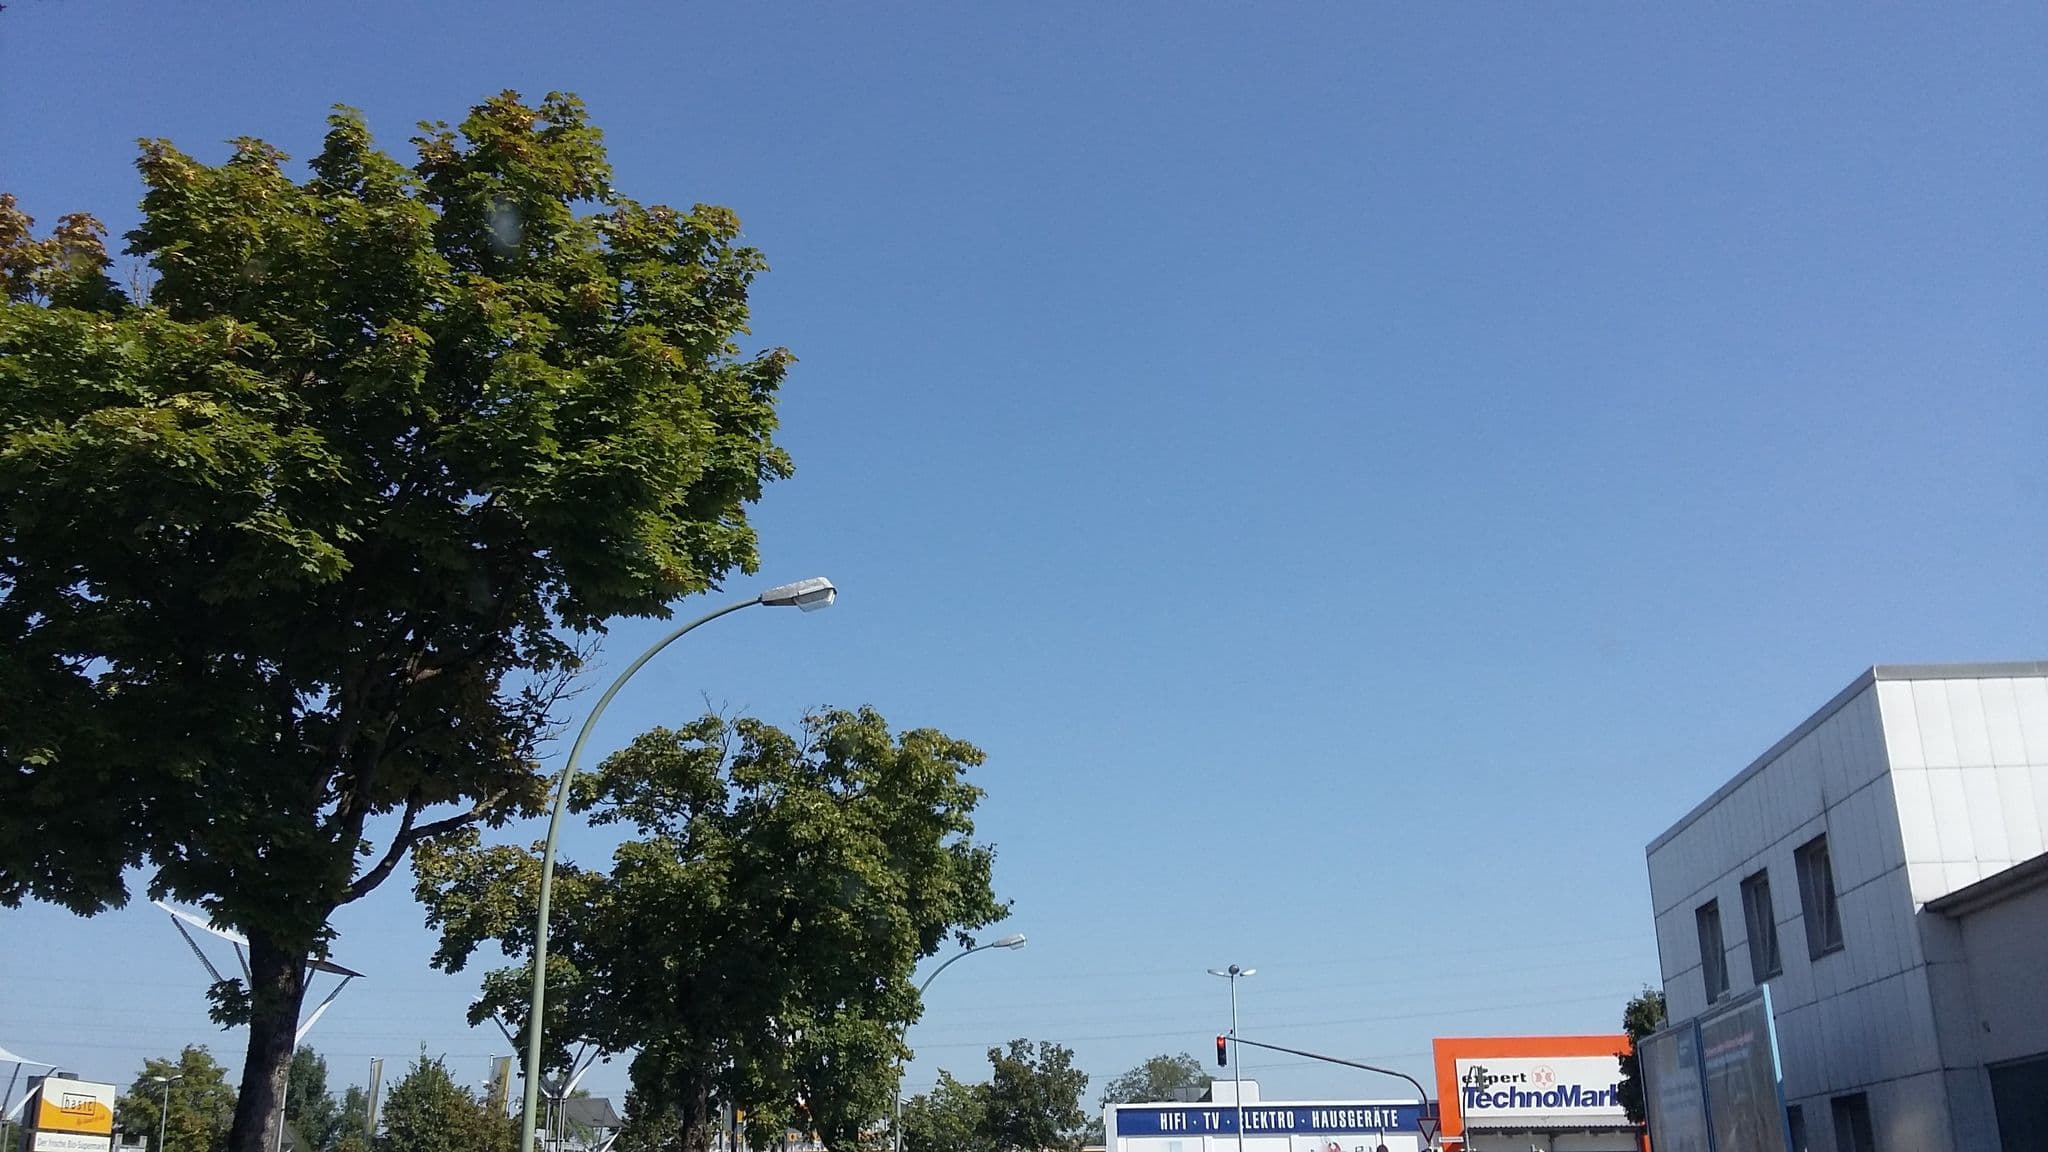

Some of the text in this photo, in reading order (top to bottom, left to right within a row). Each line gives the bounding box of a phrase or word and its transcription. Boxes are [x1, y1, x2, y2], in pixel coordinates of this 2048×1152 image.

[1462, 1073, 1527, 1085] expert
[64, 1096, 92, 1112] basic
[1160, 1112, 1187, 1130] HIFI
[1203, 1111, 1220, 1129] TV
[1311, 1106, 1398, 1128] HAUSGERÄTE
